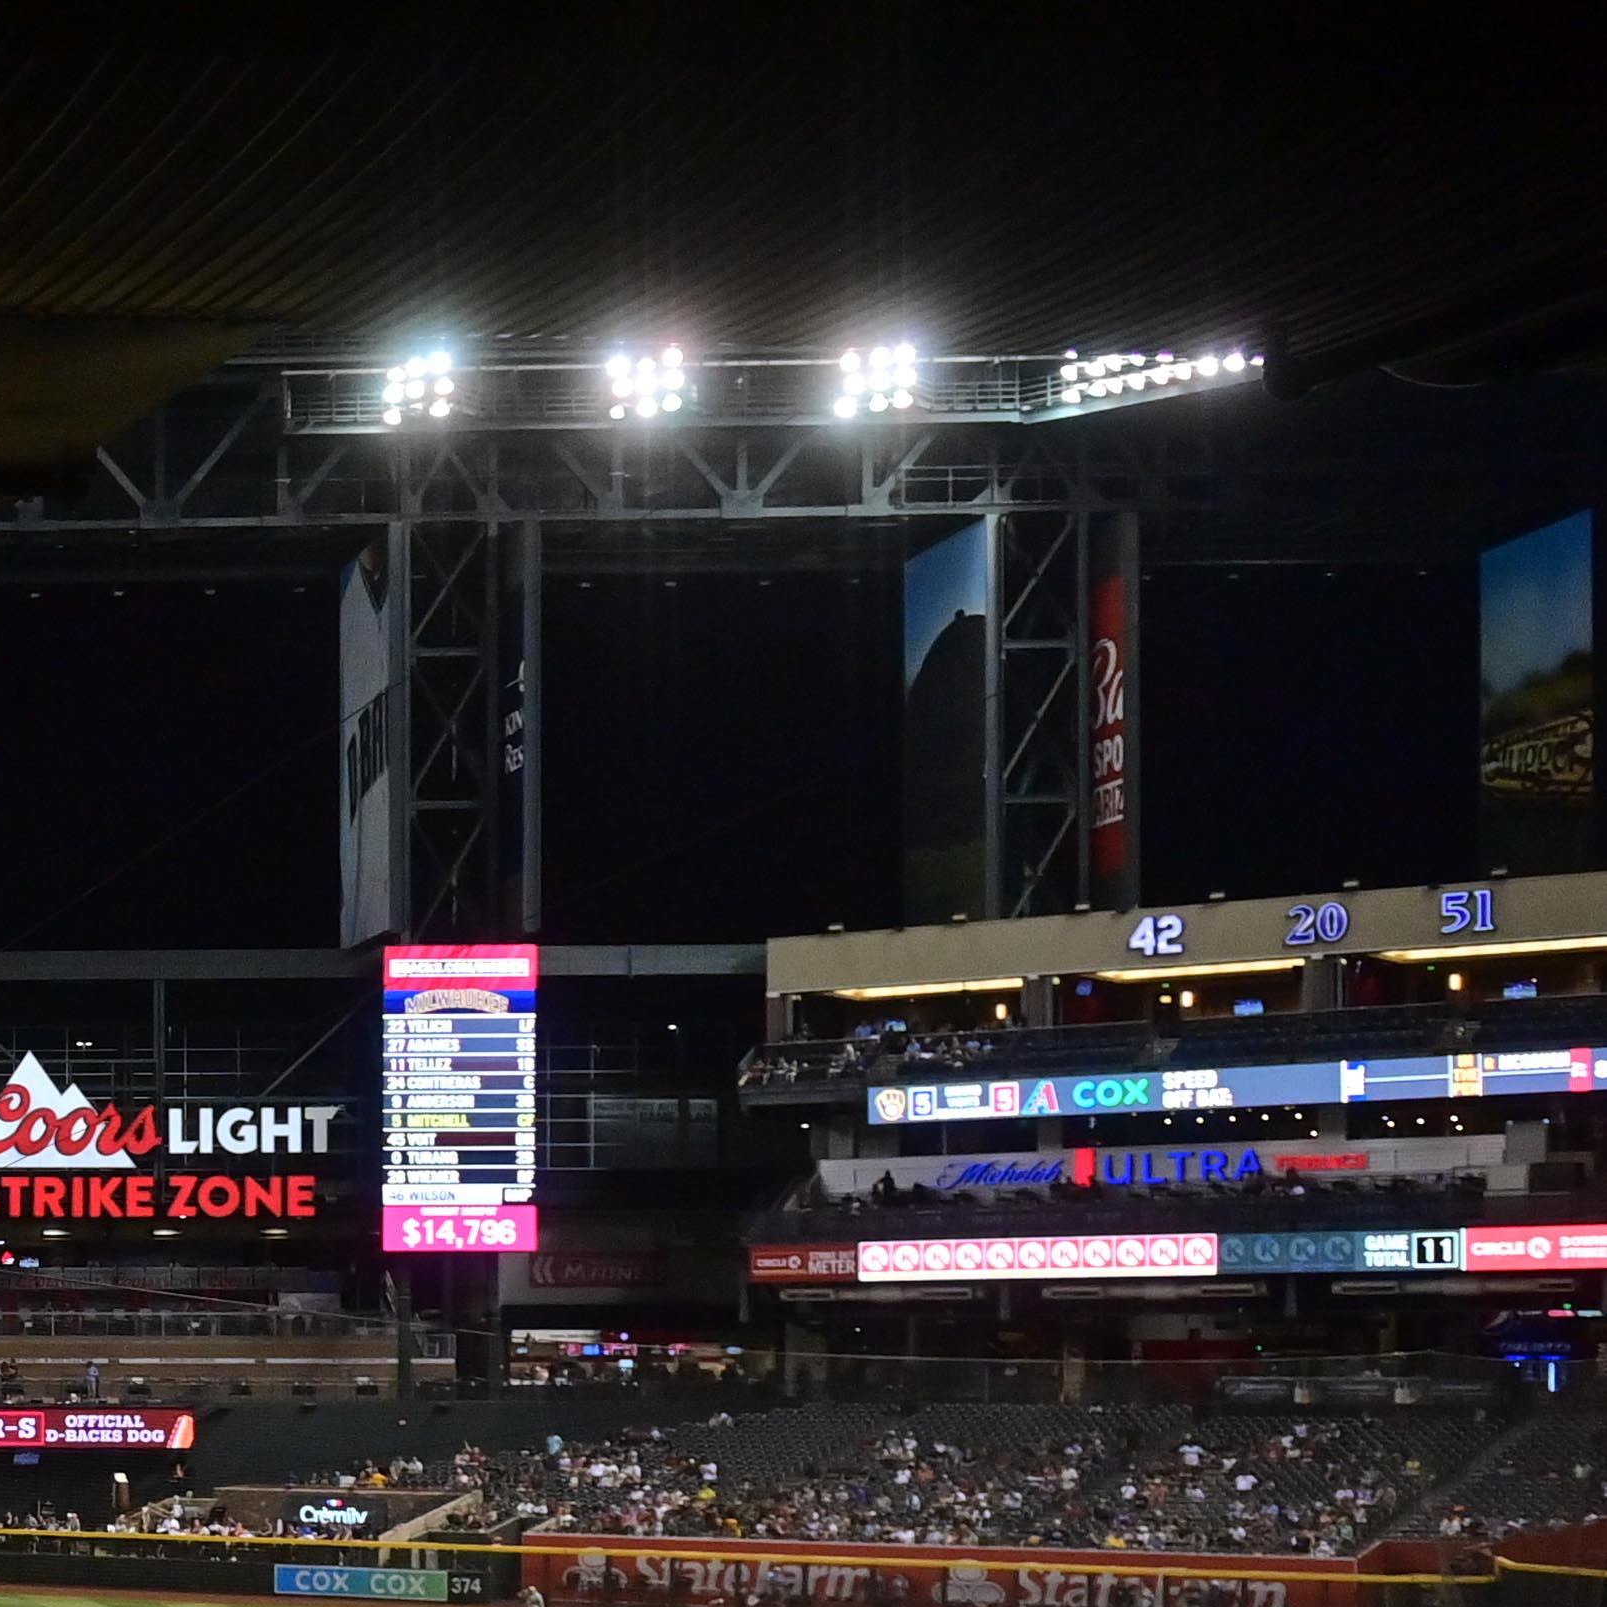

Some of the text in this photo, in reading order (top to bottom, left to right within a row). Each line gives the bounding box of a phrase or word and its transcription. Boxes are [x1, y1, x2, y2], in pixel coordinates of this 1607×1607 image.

[1441, 890, 1494, 933] 51
[1129, 914, 1184, 956] 42
[1285, 902, 1348, 945] 20
[404, 989, 510, 1014] MILWAUKEE
[387, 1058, 406, 1071] 11
[1073, 1079, 1149, 1107] COX
[168, 1105, 340, 1154] LIGHT
[937, 1161, 1065, 1189] Michelob
[1104, 1149, 1263, 1186] ULTRA
[167, 1175, 316, 1218] ZONE
[410, 1191, 455, 1201] WILSON
[402, 1218, 517, 1249] $14,796
[1364, 1235, 1452, 1263] GAME 11
[1364, 1251, 1411, 1268] TOTAL
[1471, 1242, 1525, 1256] CIRCLE
[808, 1260, 855, 1276] METER
[65, 1415, 145, 1430] OFFICIAL
[46, 1428, 165, 1444] D-BACKS DOG
[295, 1570, 349, 1591] COX
[370, 1574, 426, 1596] COX
[451, 1577, 482, 1594] 374
